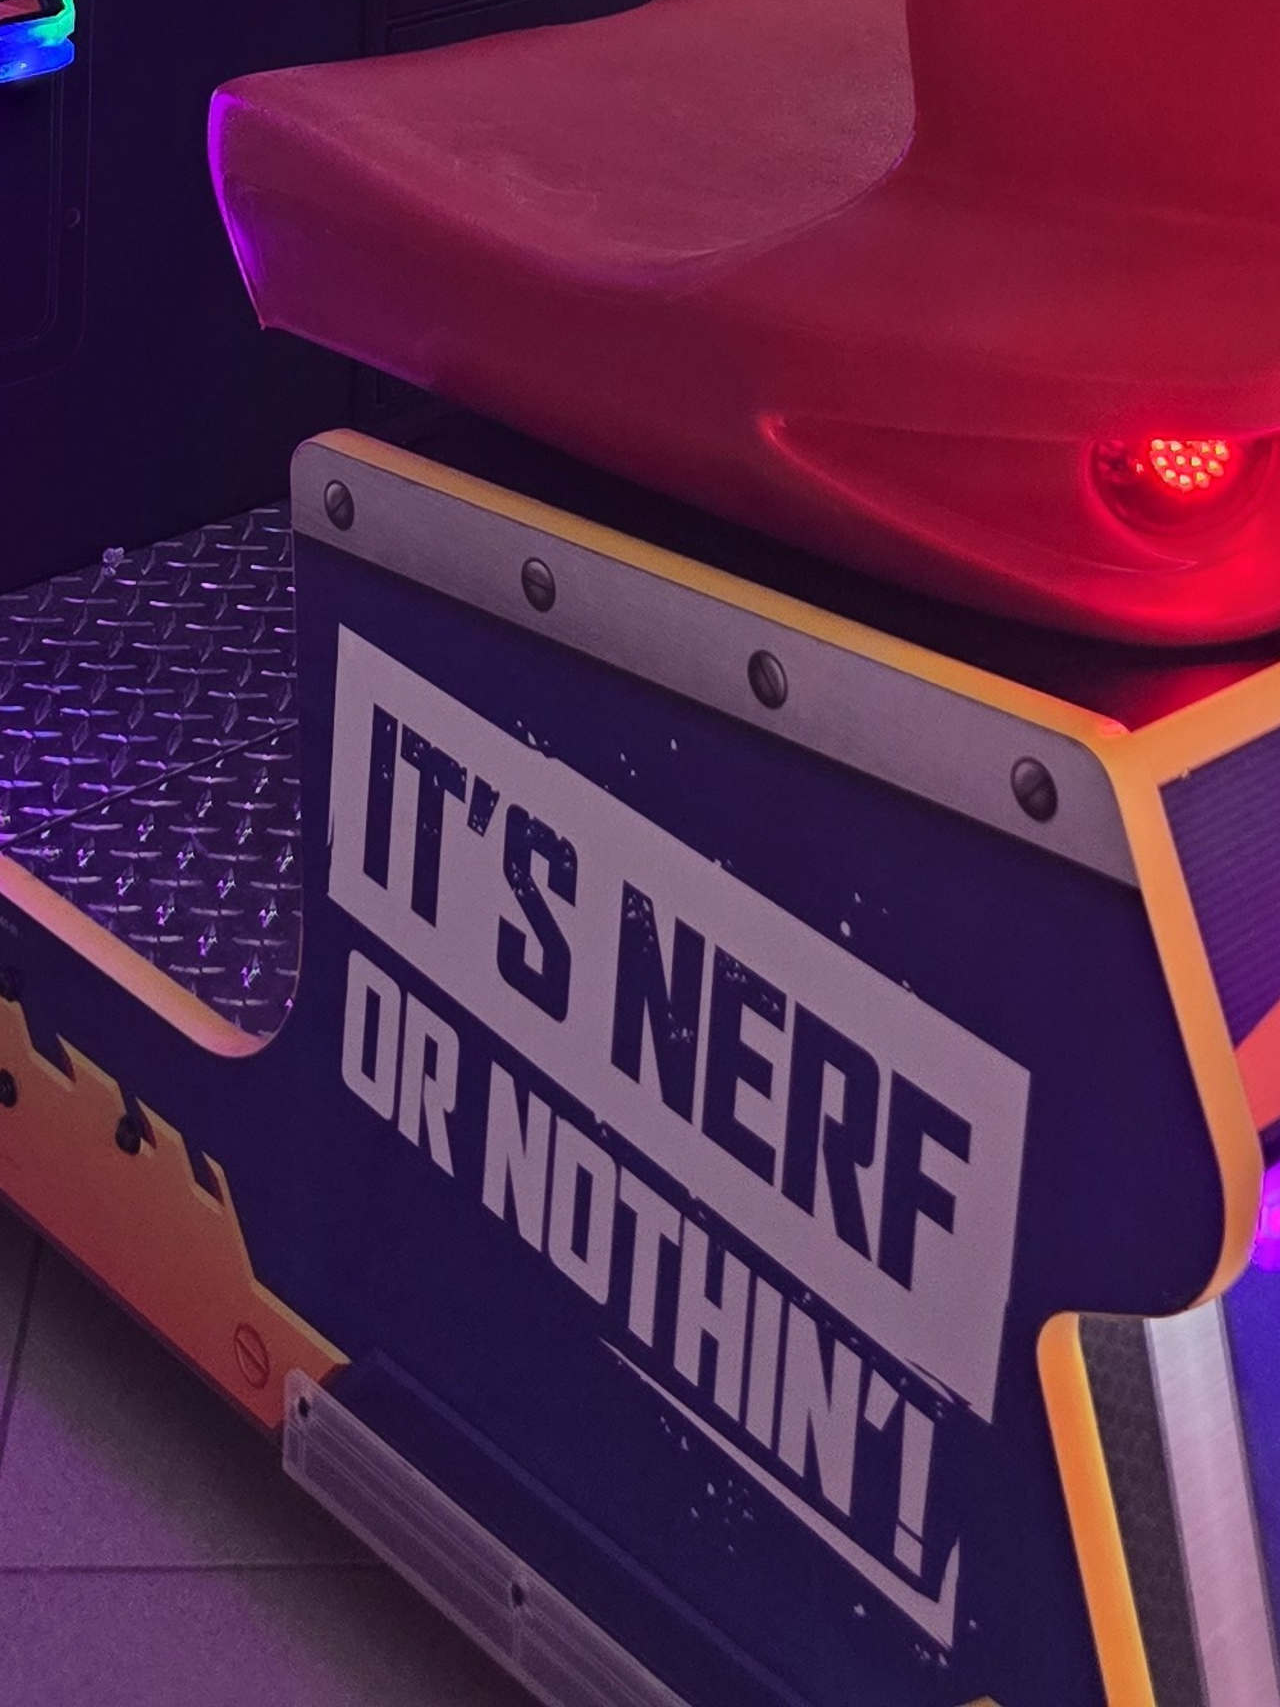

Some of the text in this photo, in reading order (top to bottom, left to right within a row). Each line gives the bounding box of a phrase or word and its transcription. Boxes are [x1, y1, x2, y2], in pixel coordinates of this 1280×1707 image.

[341, 948, 935, 1584] OR NOTHIN'!
[362, 702, 973, 1293] IT'S NERF
